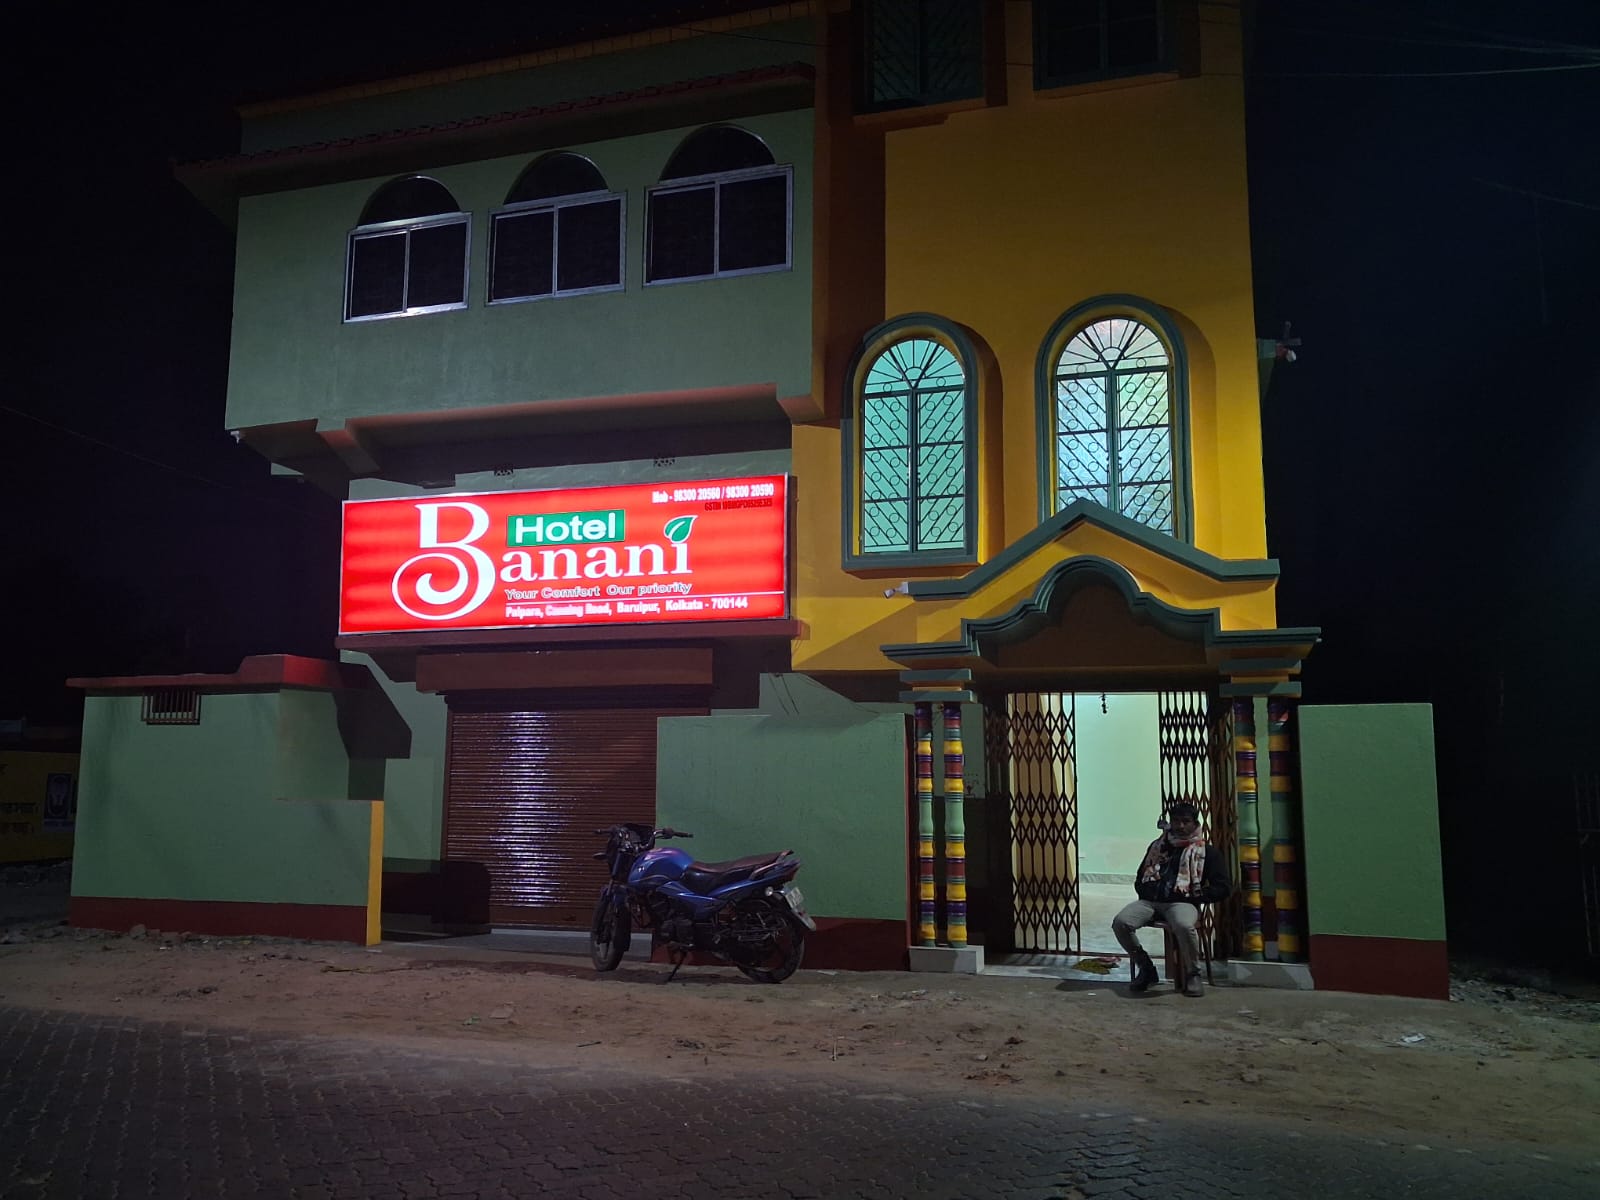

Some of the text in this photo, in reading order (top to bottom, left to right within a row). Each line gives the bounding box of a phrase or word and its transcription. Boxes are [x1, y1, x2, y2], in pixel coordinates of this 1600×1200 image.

[515, 512, 616, 543] Hotel
[391, 501, 693, 620] Banani
[505, 582, 693, 600] Your Comfort Our priority
[616, 602, 660, 614] Baruipur,
[665, 599, 703, 610] Kolkata
[711, 597, 748, 609] 700144
